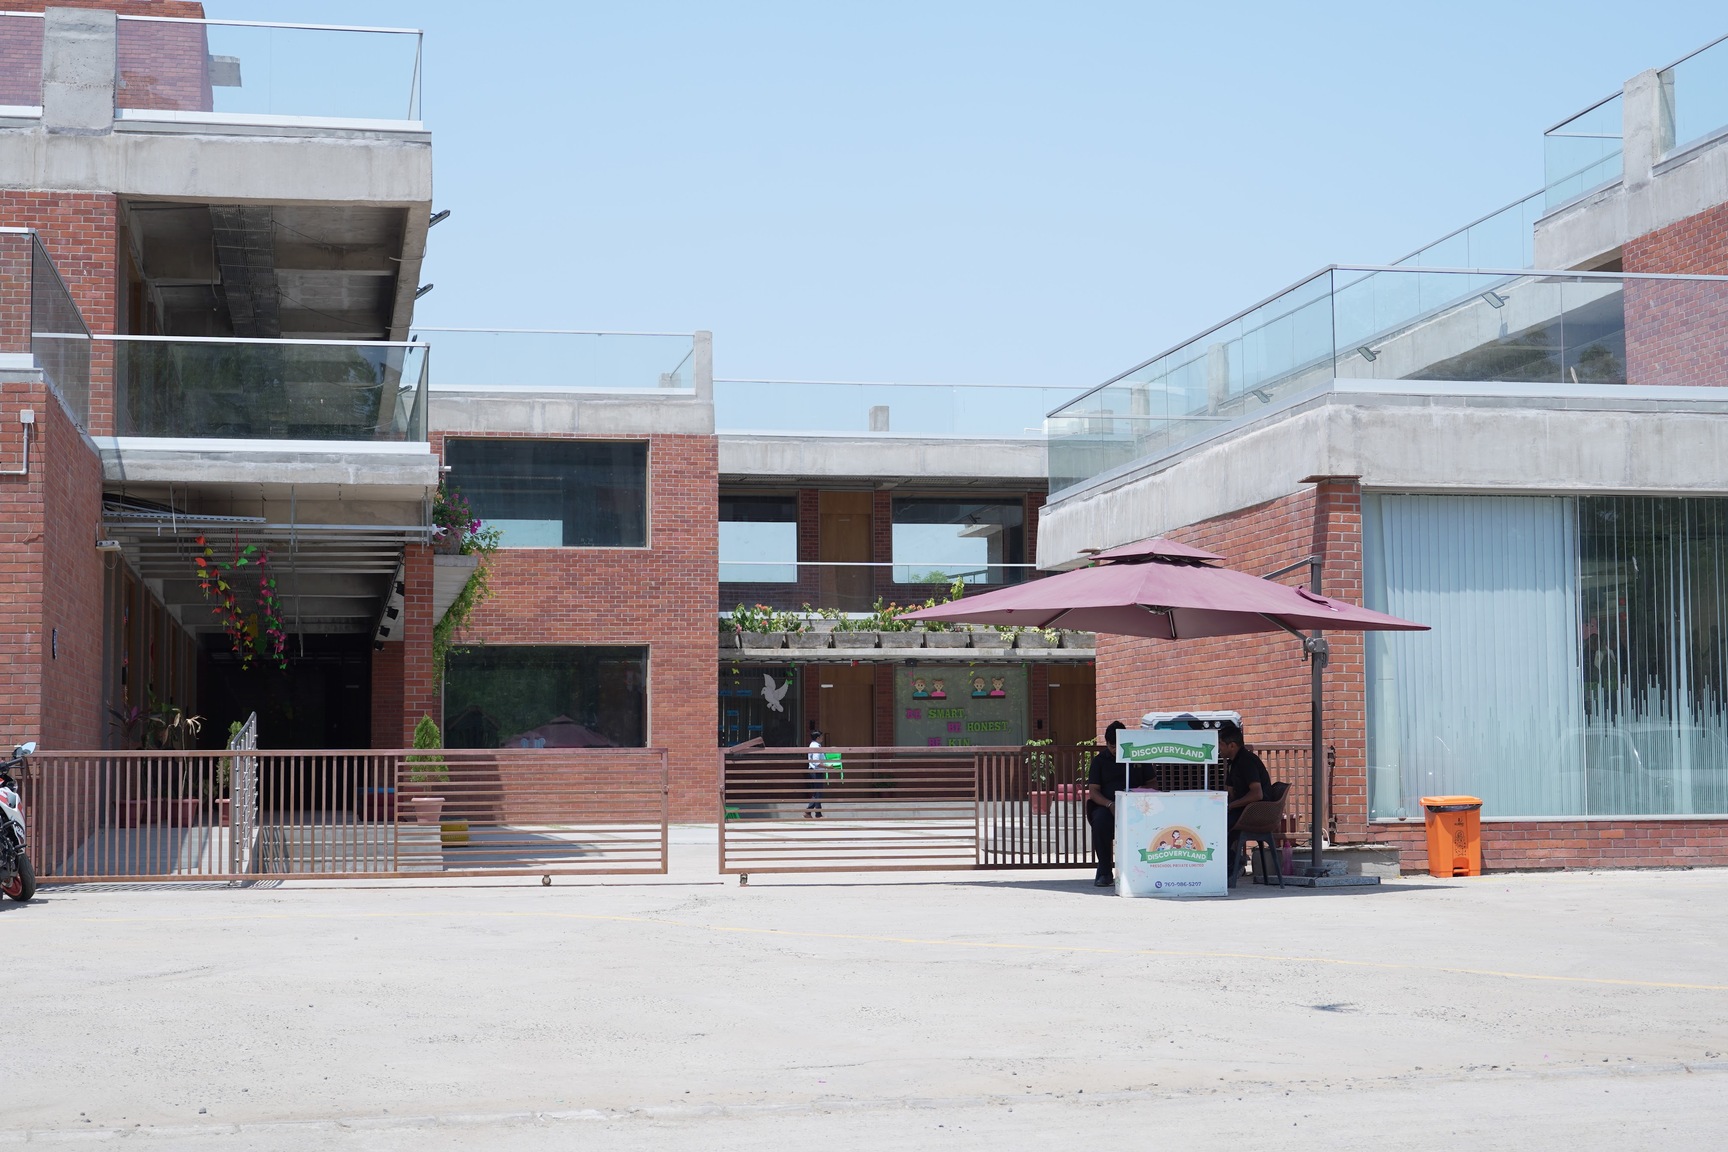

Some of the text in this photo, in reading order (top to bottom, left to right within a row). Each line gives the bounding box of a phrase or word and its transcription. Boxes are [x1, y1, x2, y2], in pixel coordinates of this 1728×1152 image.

[906, 709, 967, 719] BE SMART,
[947, 722, 1013, 733] BE HONEST,
[1131, 746, 1204, 758] DISCOVERYLAND
[1147, 850, 1206, 860] DISCOVERYLAND
